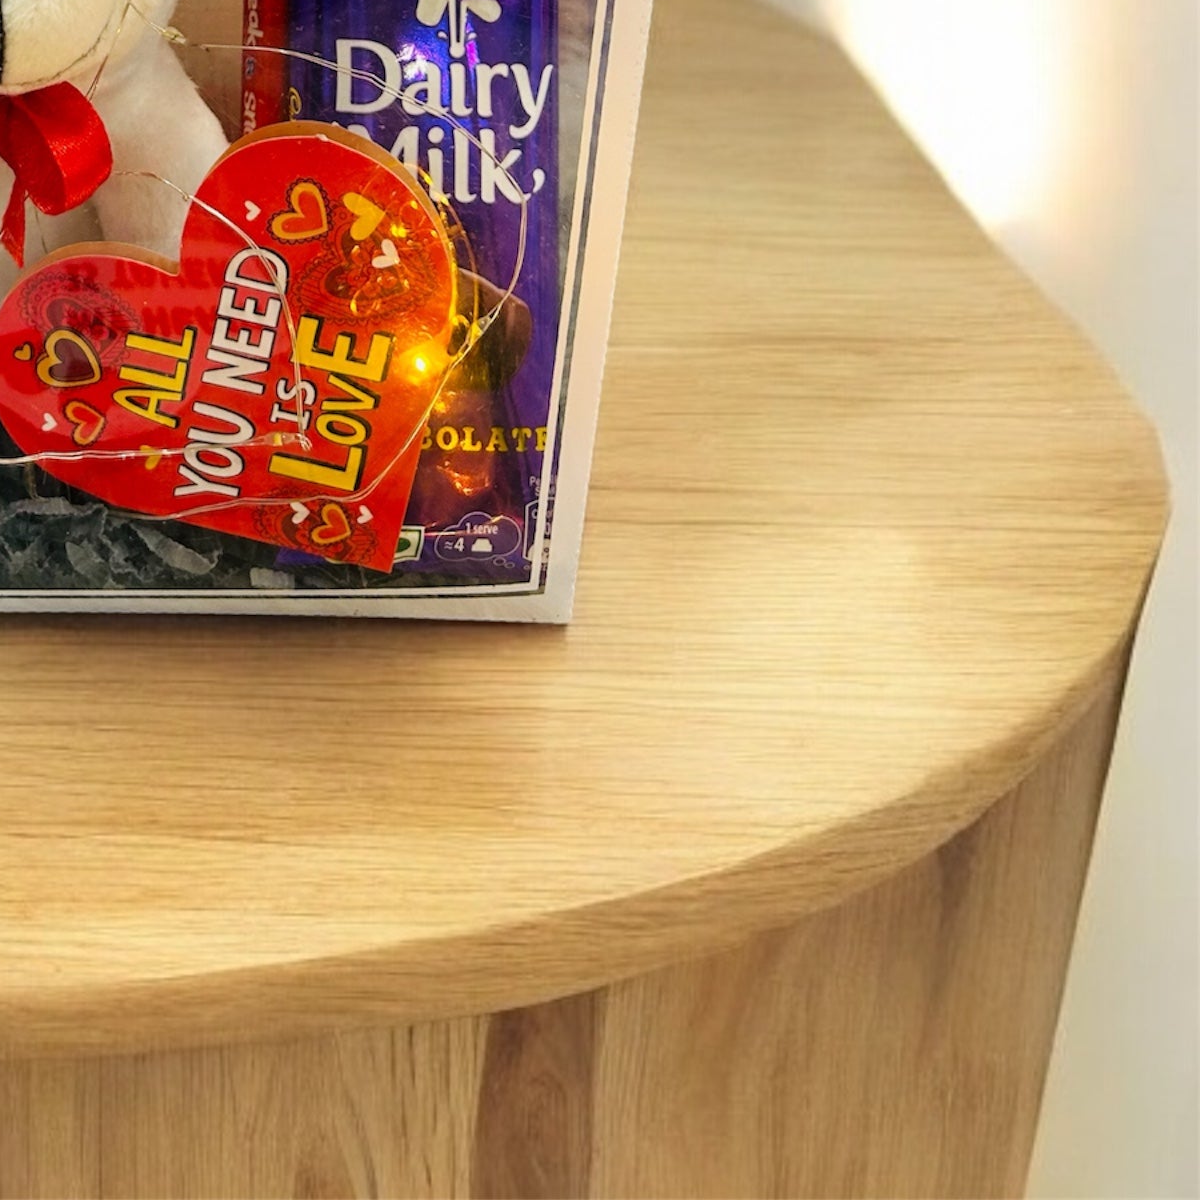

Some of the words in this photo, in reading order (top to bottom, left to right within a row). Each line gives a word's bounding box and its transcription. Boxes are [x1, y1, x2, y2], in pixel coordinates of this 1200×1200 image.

[336, 39, 554, 139] Dairy
[201, 246, 290, 395] NEED
[112, 325, 196, 428] ALL
[268, 313, 396, 492] LOVE
[270, 377, 317, 431] IS
[174, 401, 256, 498] YOU
[465, 522, 471, 534] 1
[473, 524, 498, 534] serve
